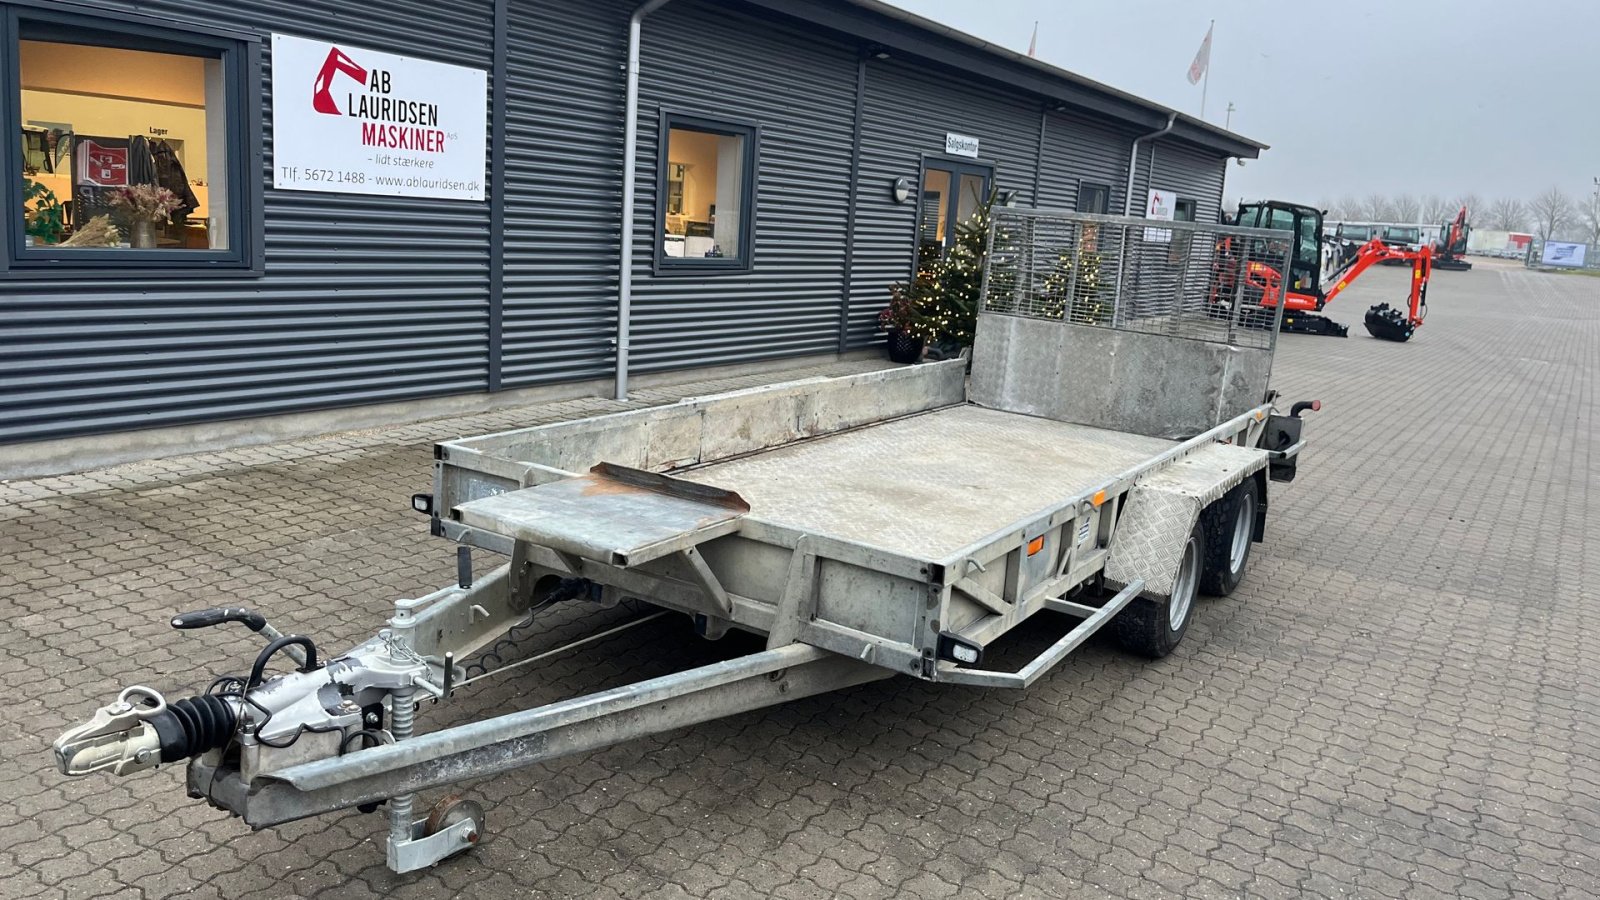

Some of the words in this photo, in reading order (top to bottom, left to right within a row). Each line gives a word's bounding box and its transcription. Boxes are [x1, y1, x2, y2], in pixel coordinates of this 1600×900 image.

[369, 69, 391, 94] AB
[348, 92, 438, 127] LAURIDSEN
[149, 126, 168, 136] Lager
[362, 122, 445, 153] MASKINER
[446, 132, 458, 141] ApS
[947, 136, 978, 152] Salgskontor
[375, 154, 391, 166] lidt
[393, 155, 434, 169] stærkere
[281, 166, 301, 183] Tlf.
[305, 168, 334, 182] 5672
[337, 171, 365, 184] 1488
[375, 176, 480, 192] www.ablauridsen.dk
